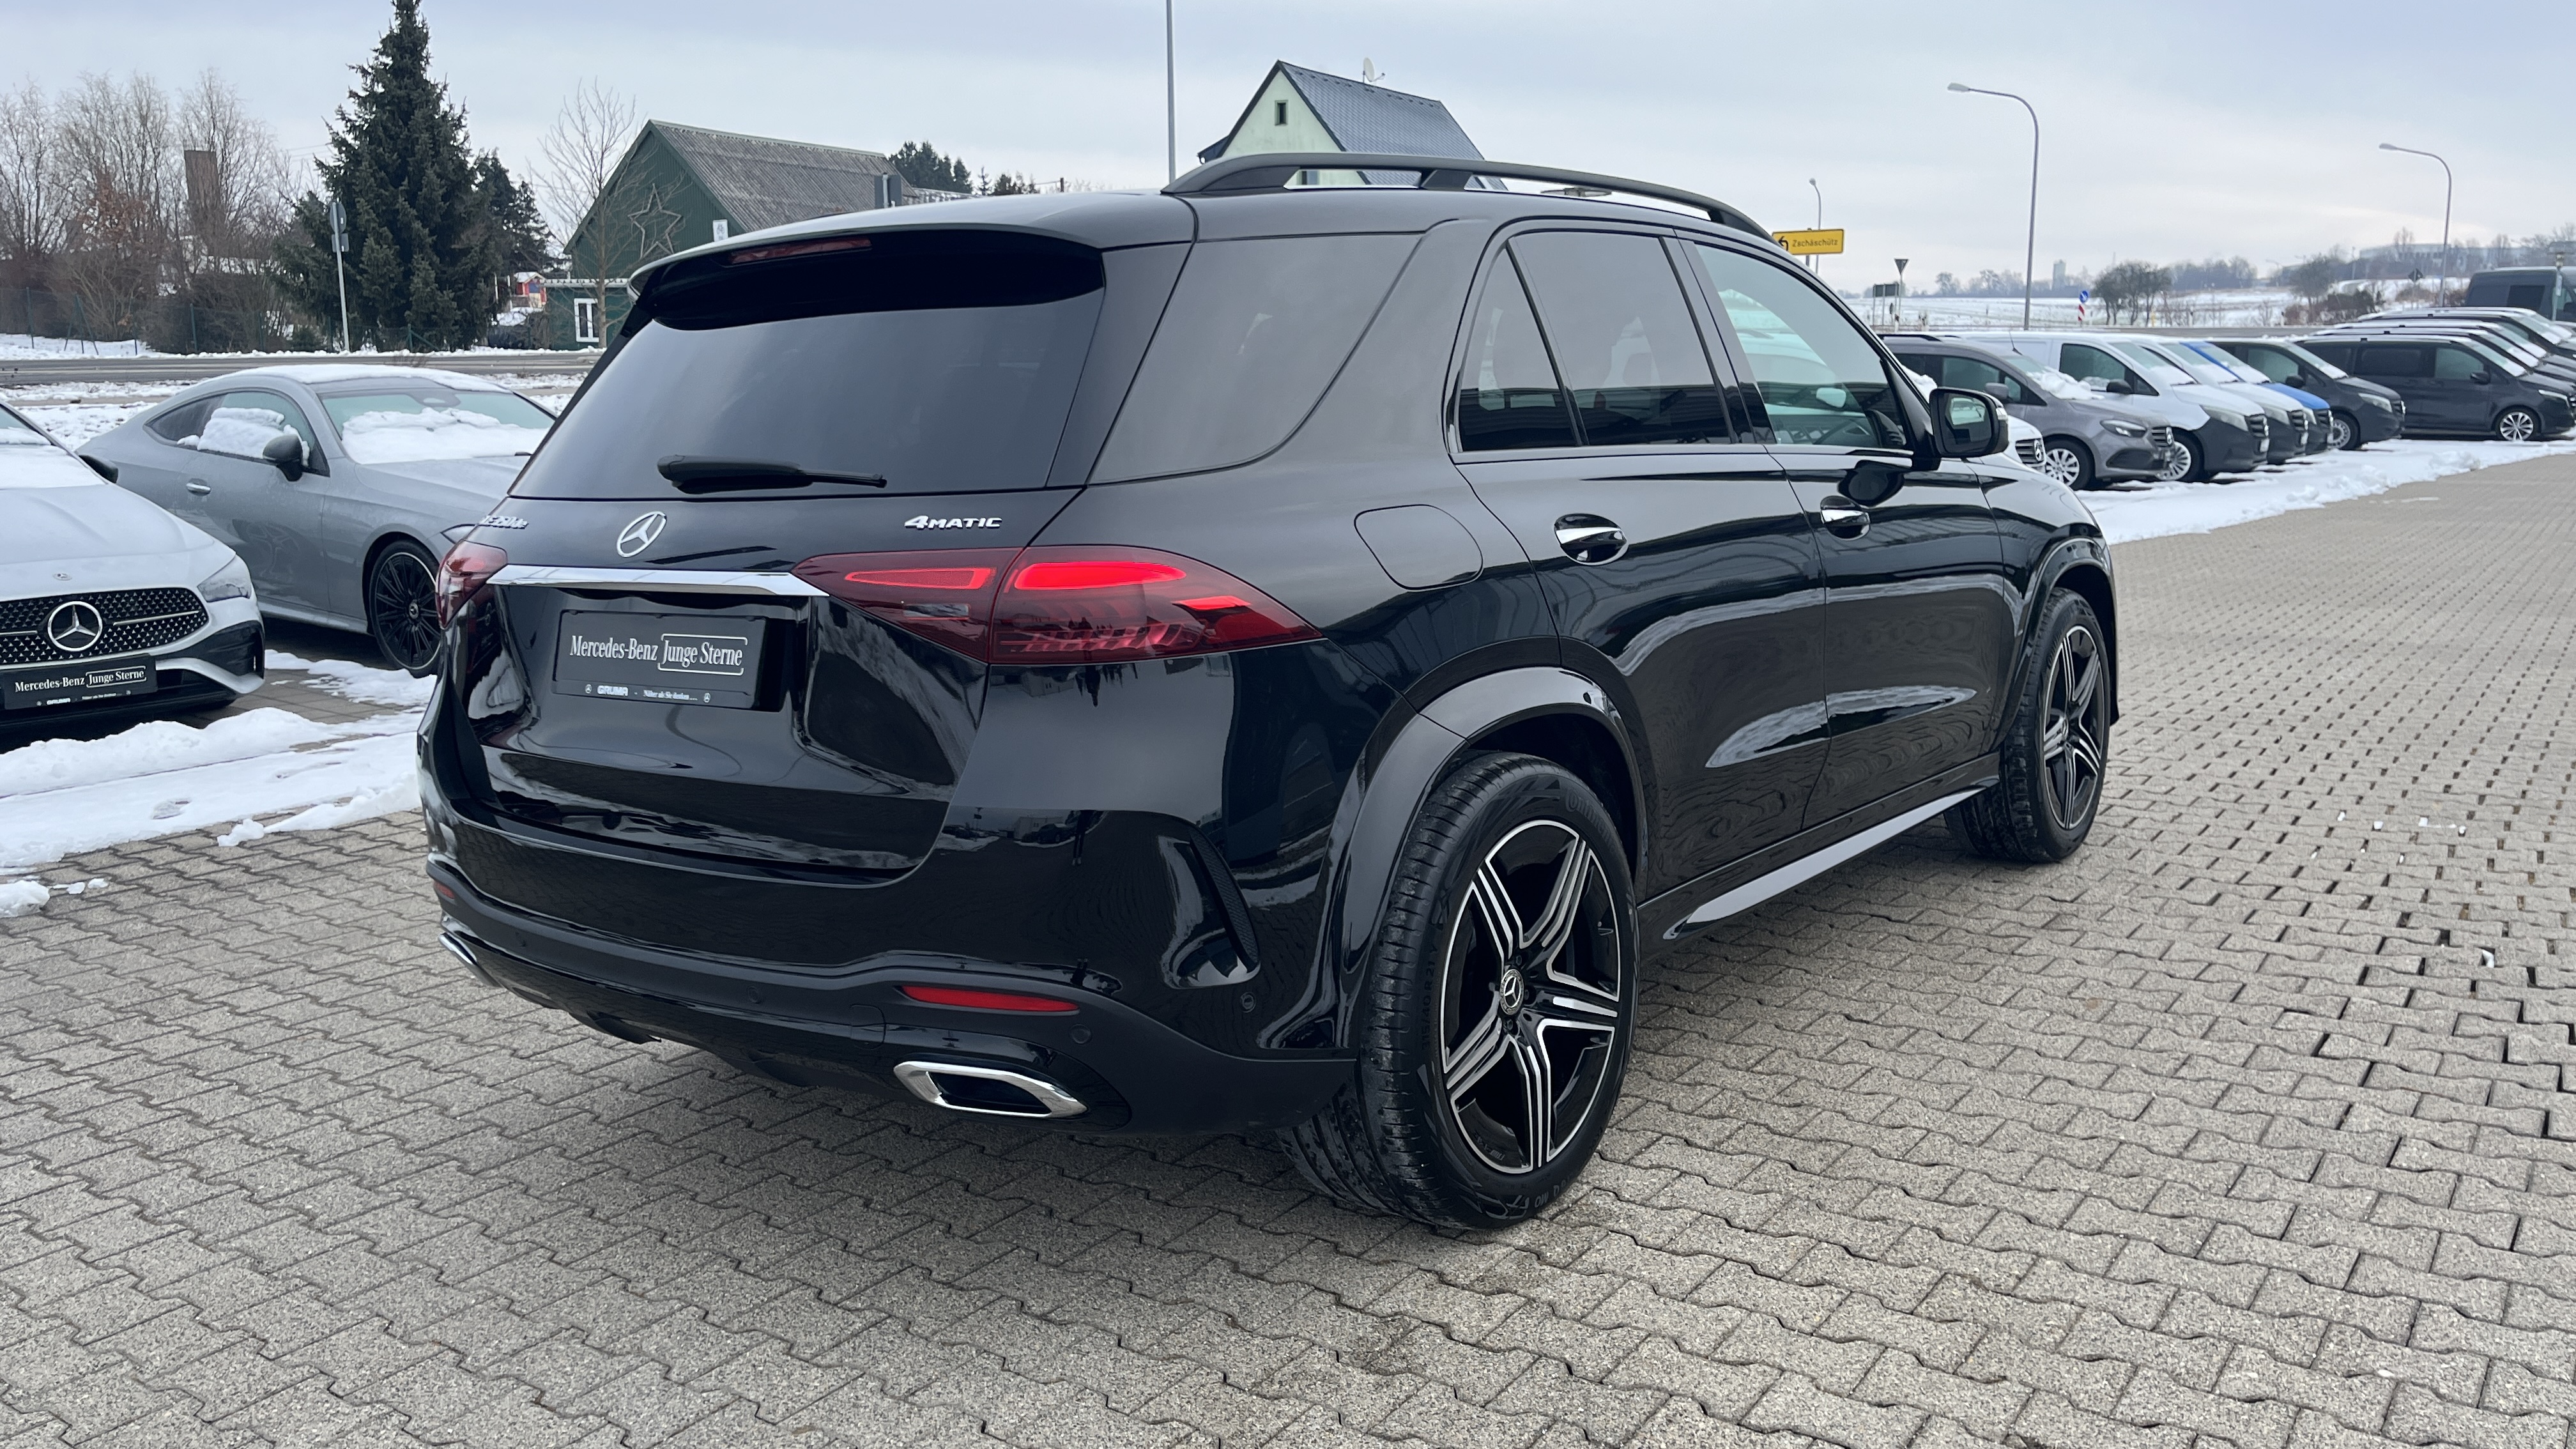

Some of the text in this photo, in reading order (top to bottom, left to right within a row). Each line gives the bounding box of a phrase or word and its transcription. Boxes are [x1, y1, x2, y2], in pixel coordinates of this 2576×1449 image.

[904, 515, 1002, 530] 4MATIC
[569, 635, 743, 668] Mercedes-Benz Junge Sterne
[15, 670, 144, 693] Mercedes-Benz Junge Sterne
